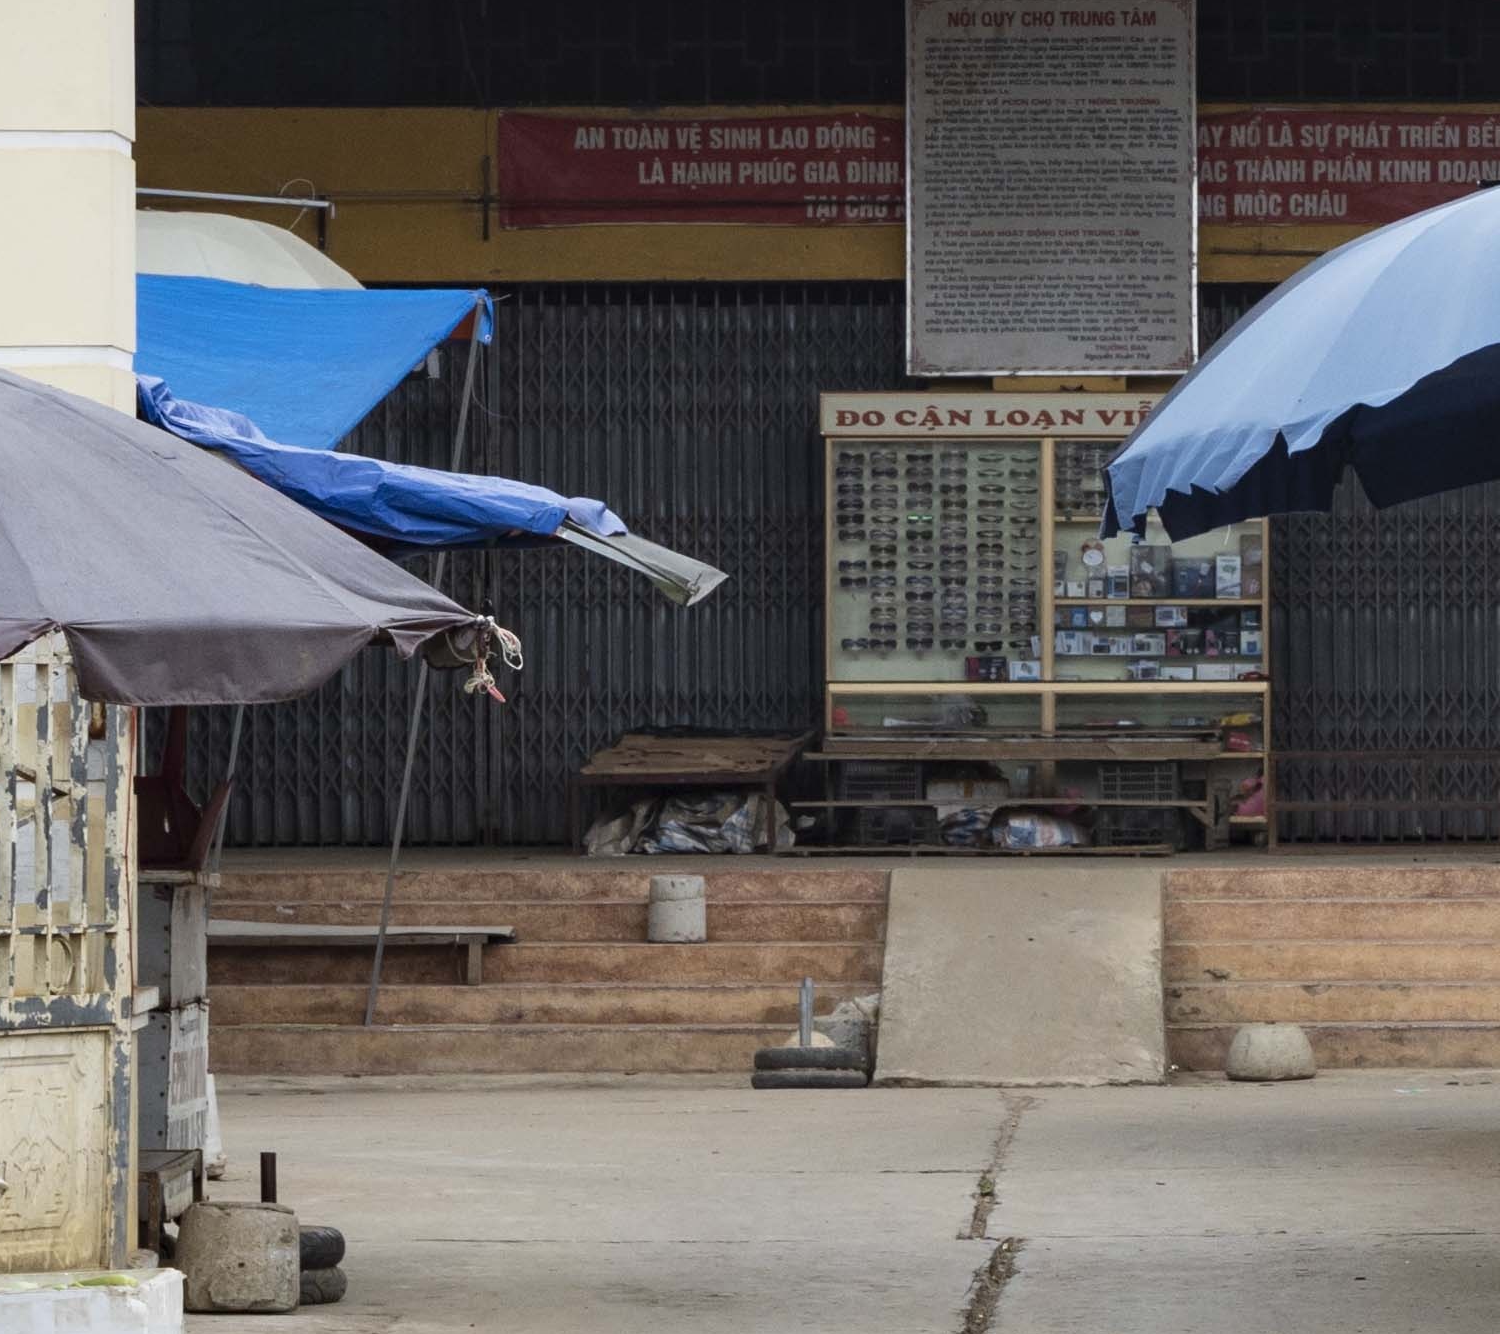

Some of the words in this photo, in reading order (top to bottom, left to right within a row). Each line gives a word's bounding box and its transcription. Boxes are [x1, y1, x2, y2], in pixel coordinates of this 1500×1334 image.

[981, 10, 1015, 28] QUY
[1021, 10, 1055, 31] CHỢ
[1060, 11, 1116, 28] TRUNG
[1121, 7, 1157, 27] TÂM
[574, 127, 605, 150] AN
[612, 124, 669, 150] TOÀN
[675, 123, 702, 154] VỆ
[710, 127, 761, 150] SINH
[768, 127, 808, 150] LAO
[815, 121, 875, 153] ĐỘNG
[1229, 115, 1263, 148] NỔ
[1267, 120, 1294, 148] LÀ
[1300, 121, 1333, 153] SỰ
[1336, 120, 1392, 149] PHÁT
[1398, 117, 1460, 148] TRIỂN
[638, 158, 664, 185] LÀ
[671, 161, 732, 190] HẠNH
[739, 157, 796, 185] PHÚC
[804, 161, 840, 184] GIA
[1234, 155, 1306, 182] THÀNH
[1313, 152, 1372, 182] PHẦN
[1379, 160, 1430, 182] KINH
[1233, 190, 1284, 221] MỘC
[1289, 189, 1348, 217] CHÂU
[835, 409, 885, 427] ĐO
[894, 404, 972, 431] CẬN
[985, 409, 1085, 431] LOẠN
[1096, 399, 1151, 427] VIỄ
